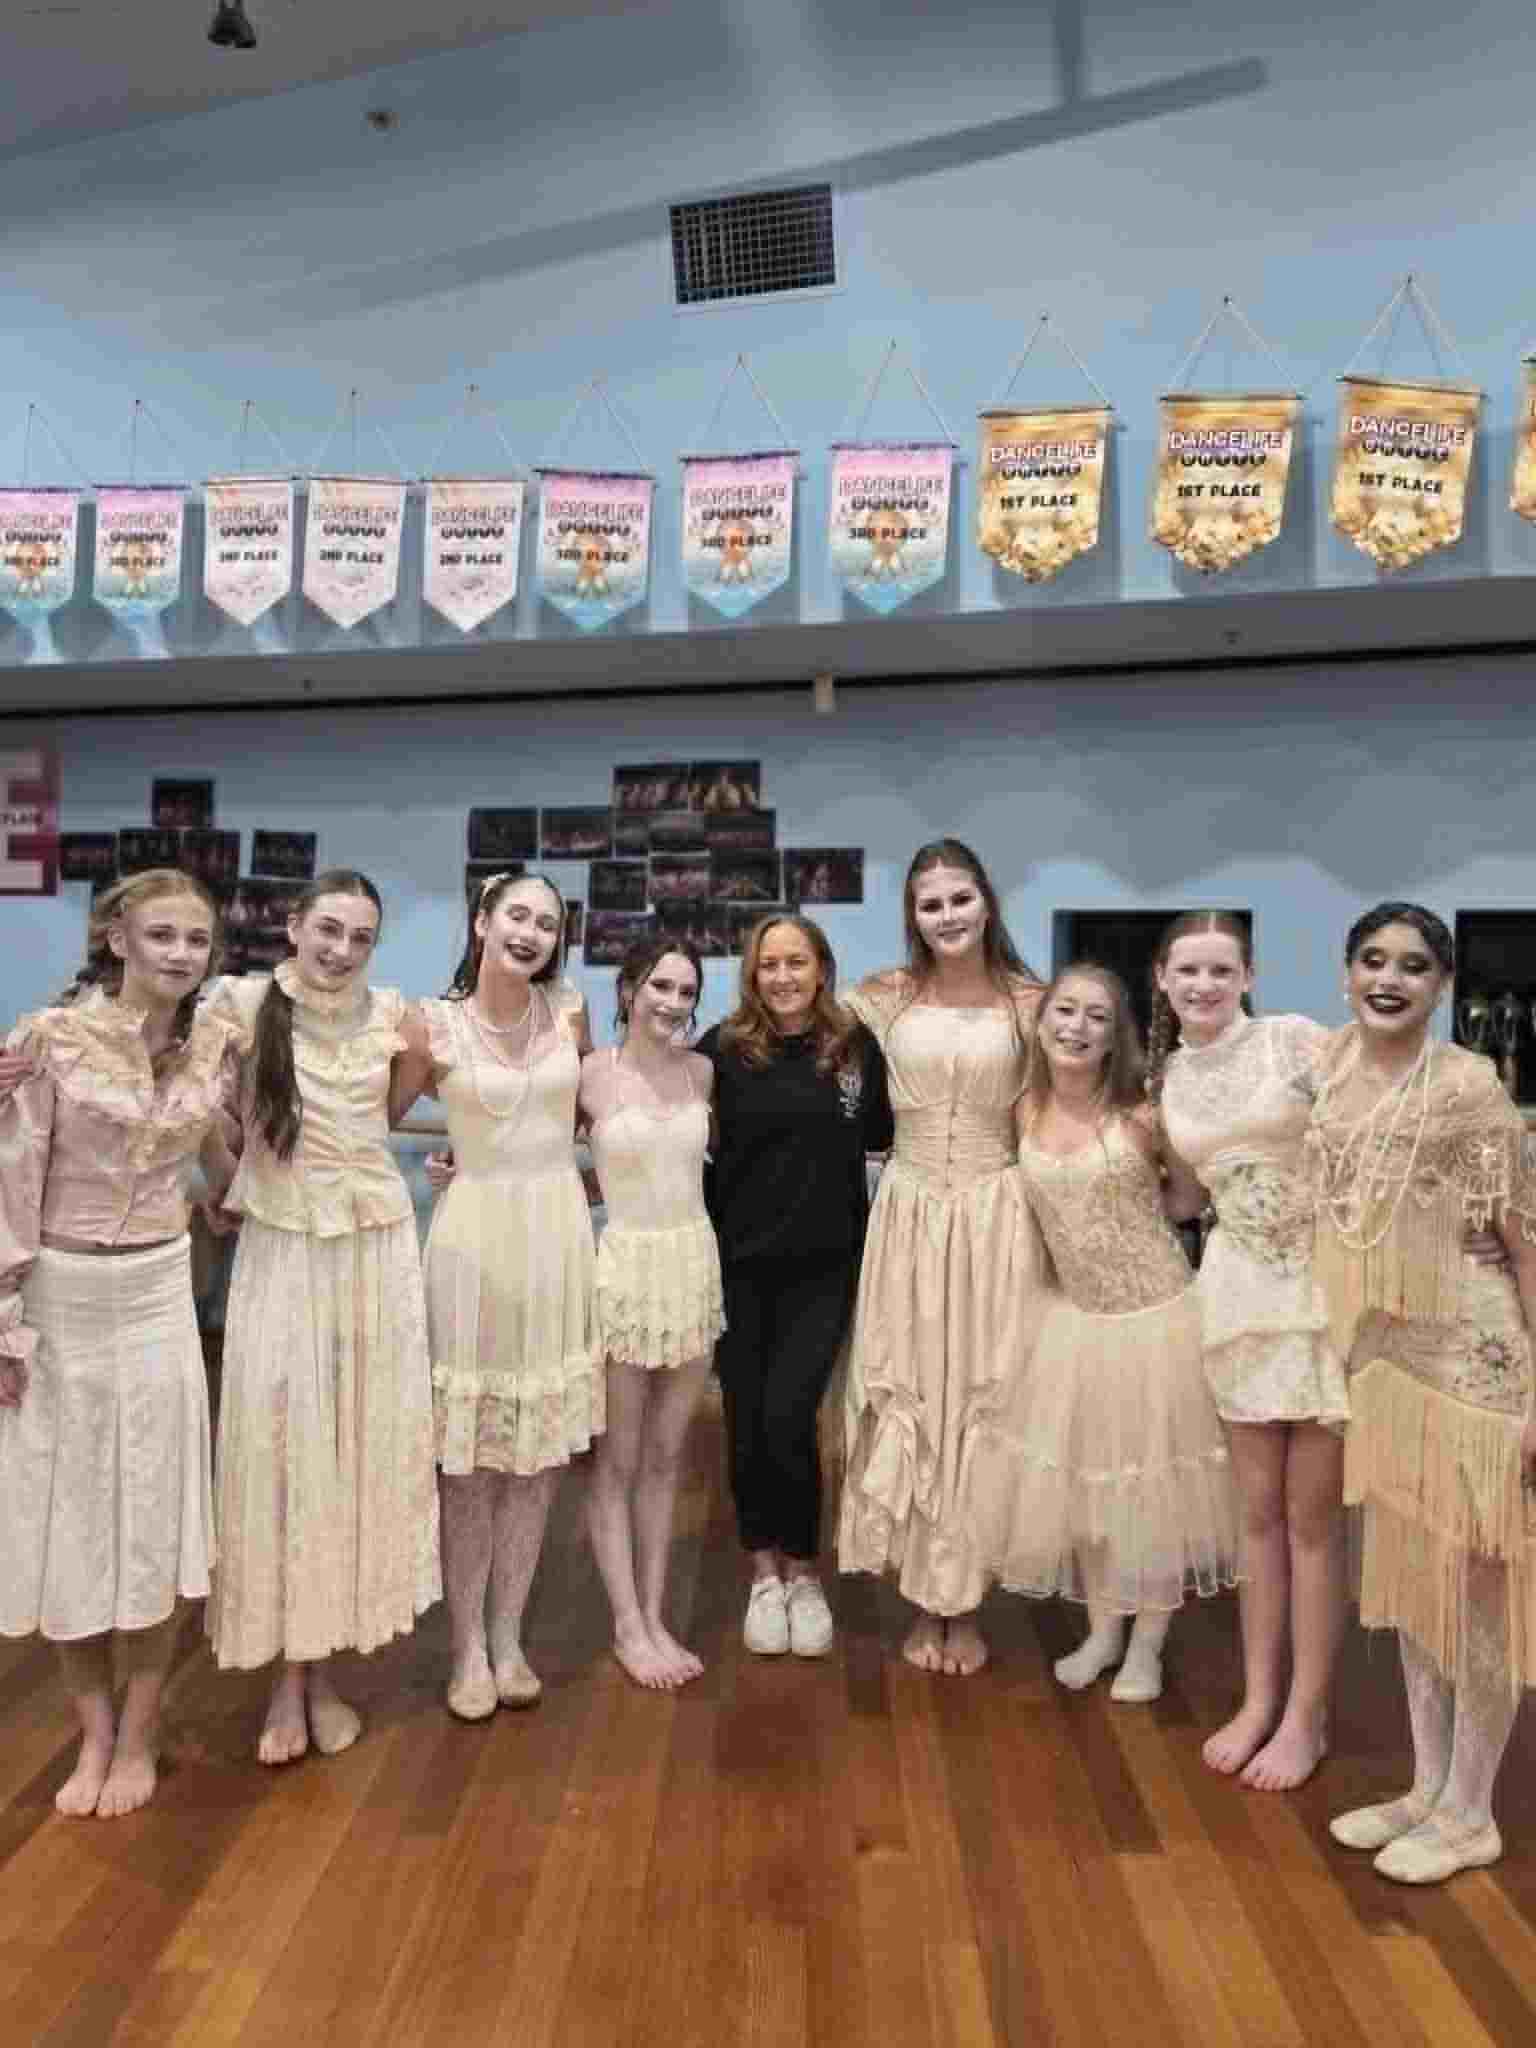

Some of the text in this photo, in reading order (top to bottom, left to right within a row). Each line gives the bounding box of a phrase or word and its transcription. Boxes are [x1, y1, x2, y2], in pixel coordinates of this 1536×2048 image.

[1359, 471, 1443, 494] 1ST PLACE
[1177, 484, 1262, 497] 1ST PLACE
[1000, 493, 1079, 510] 1ST PLACE
[880, 527, 928, 540] PLACE
[346, 551, 384, 564] PLACE
[464, 552, 503, 565] PLACE
